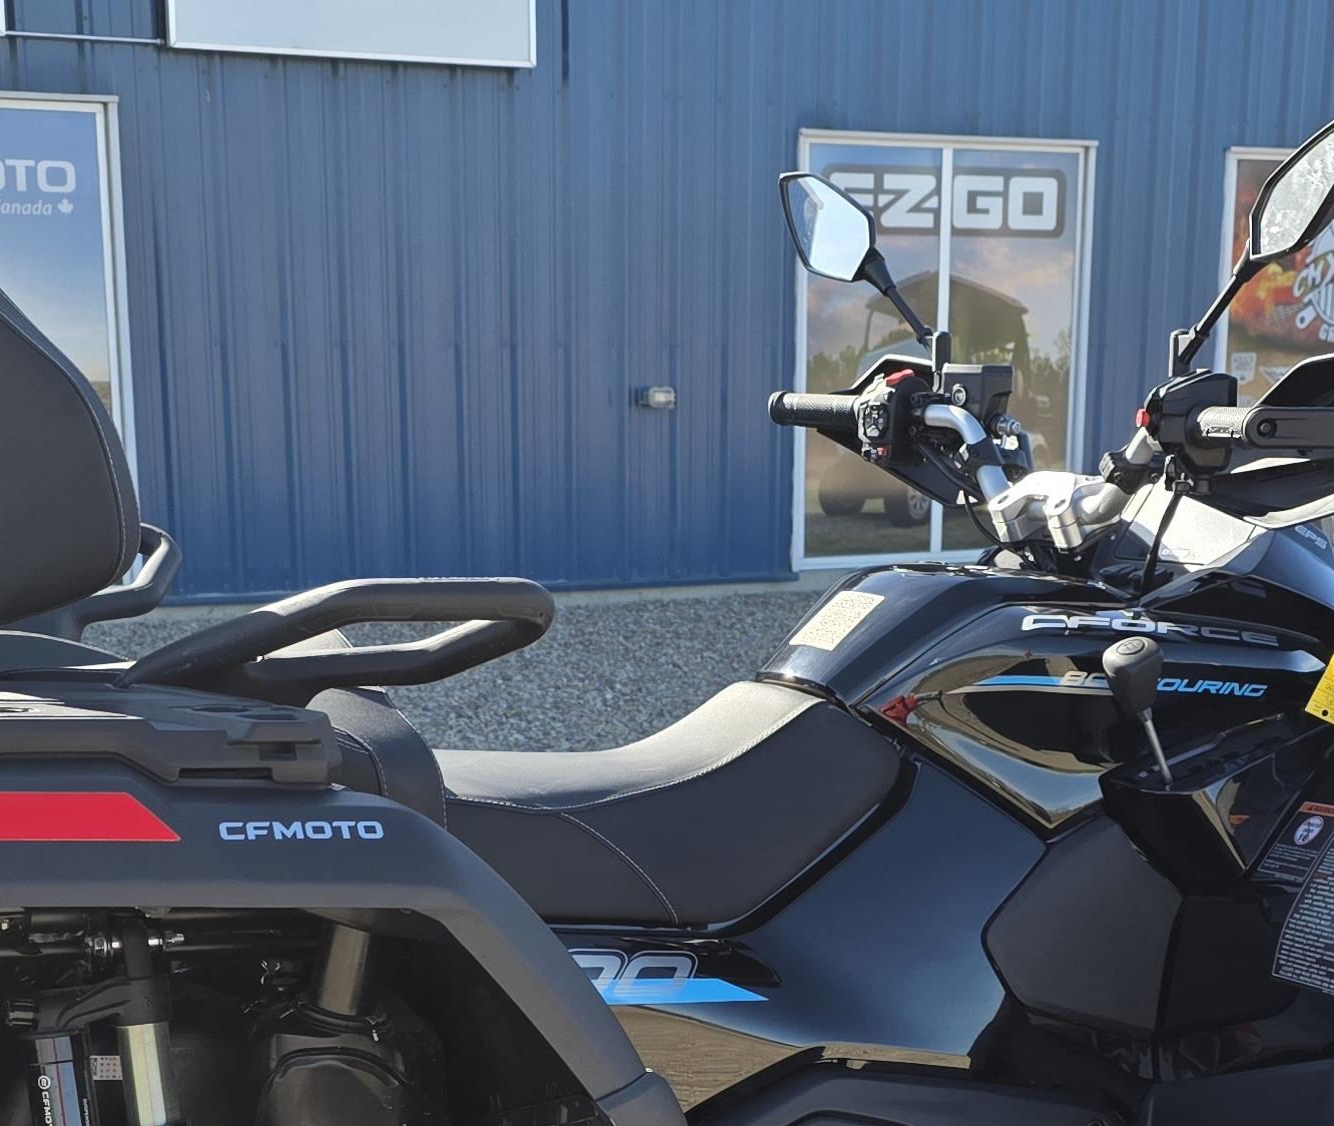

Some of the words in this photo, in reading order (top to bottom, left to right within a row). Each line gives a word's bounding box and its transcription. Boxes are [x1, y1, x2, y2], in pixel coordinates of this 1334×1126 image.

[1294, 524, 1328, 550] EPS
[1020, 613, 1281, 648] CFORCE
[1155, 675, 1268, 699] OURING
[218, 820, 385, 841] CFMOTO
[567, 948, 699, 998] 00
